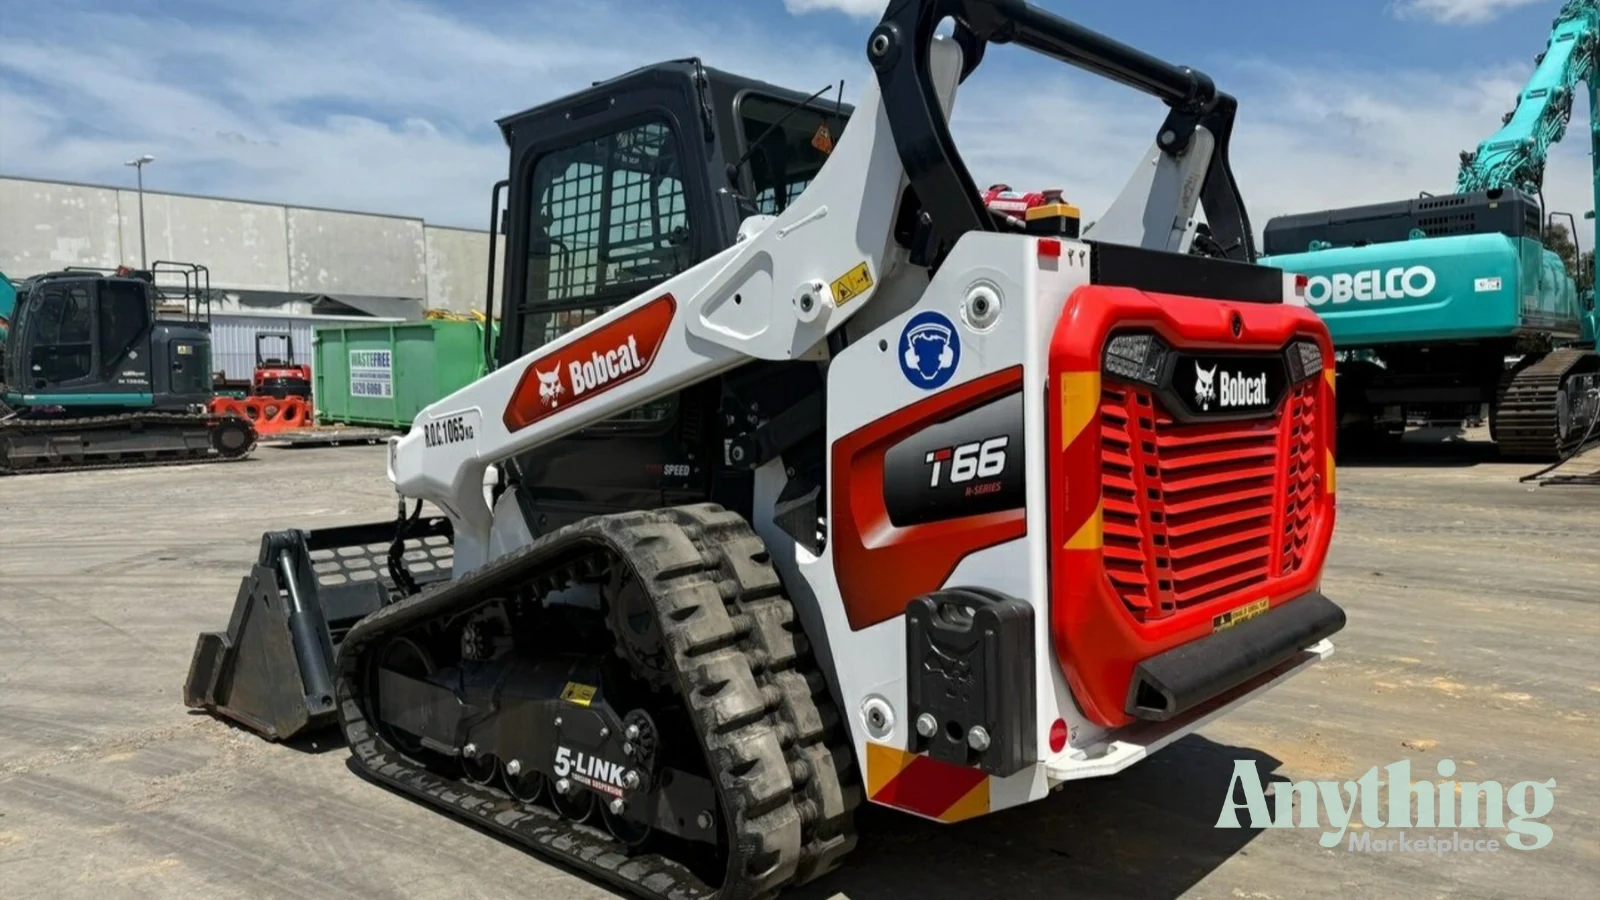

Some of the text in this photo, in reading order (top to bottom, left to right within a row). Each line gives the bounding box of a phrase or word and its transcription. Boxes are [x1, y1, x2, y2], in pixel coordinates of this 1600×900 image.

[1304, 265, 1436, 306] OBELCO
[352, 352, 390, 367] WASTEFREE
[569, 334, 640, 396] Bobcat
[1220, 371, 1267, 407] Bobcat
[664, 464, 690, 475] SPEED
[926, 436, 1008, 487] T66
[553, 746, 625, 788] 5-LINK
